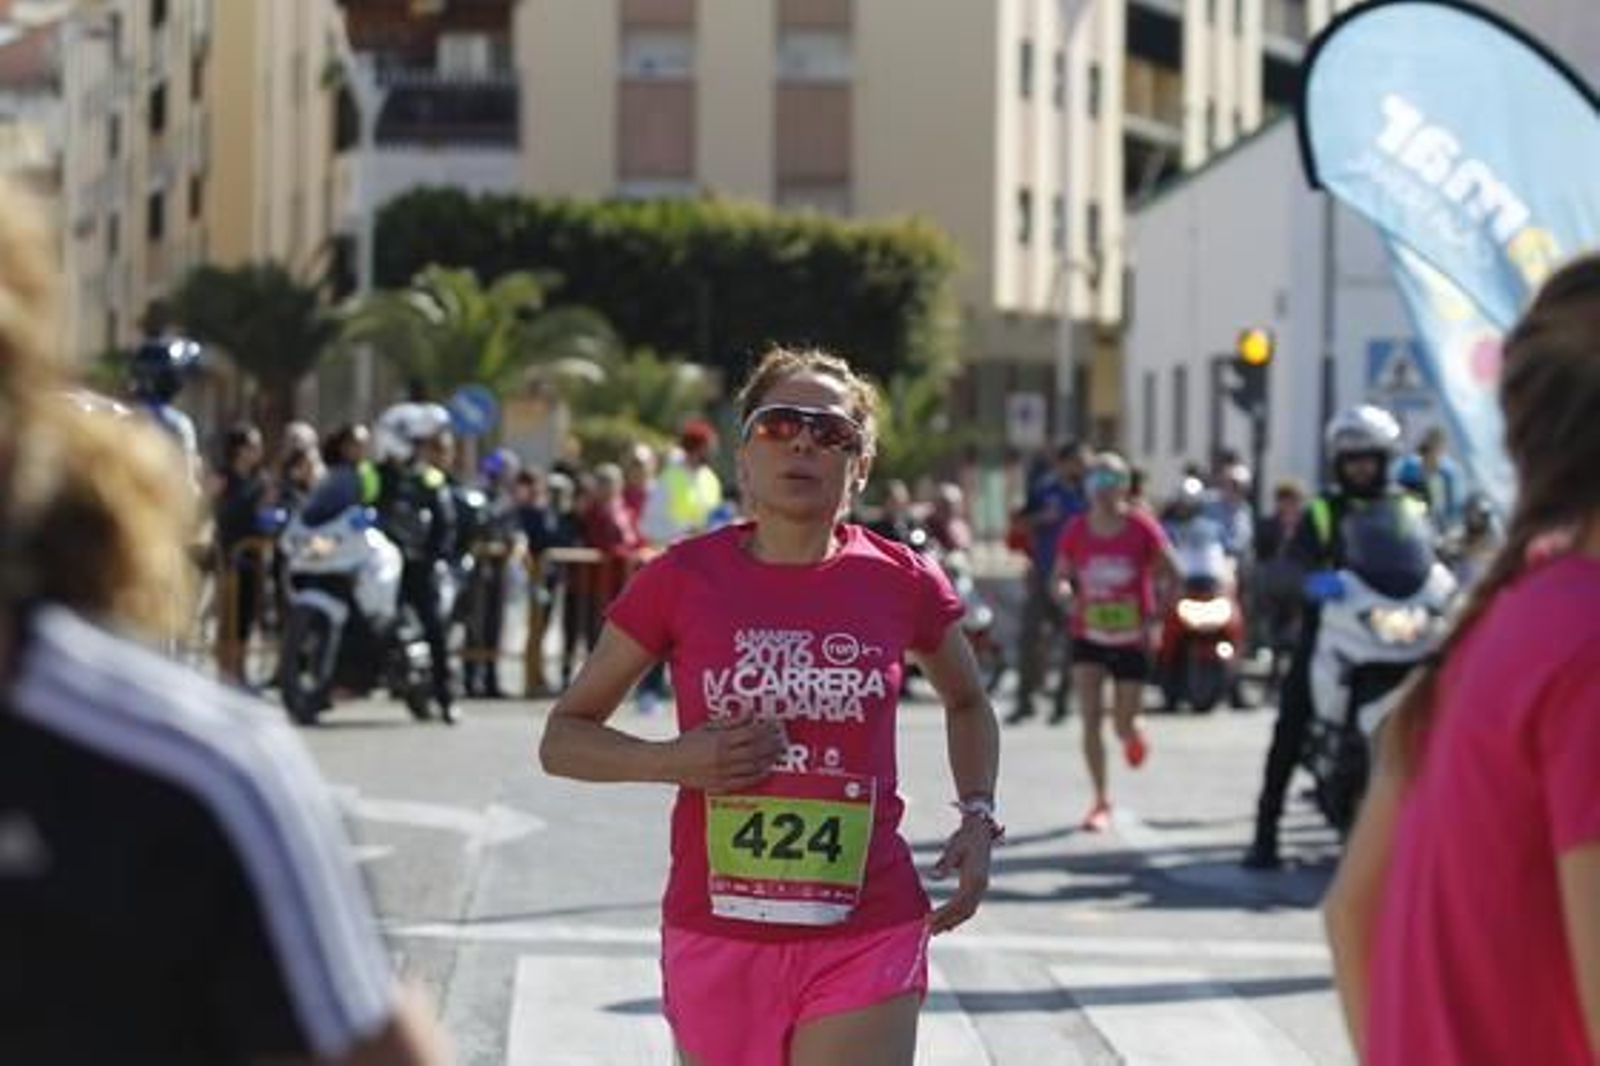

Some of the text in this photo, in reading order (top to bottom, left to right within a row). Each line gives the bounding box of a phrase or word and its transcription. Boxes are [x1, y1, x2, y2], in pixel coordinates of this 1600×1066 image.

[735, 641, 815, 668] 2016
[733, 666, 886, 699] CARRERA
[732, 811, 843, 863] 424
